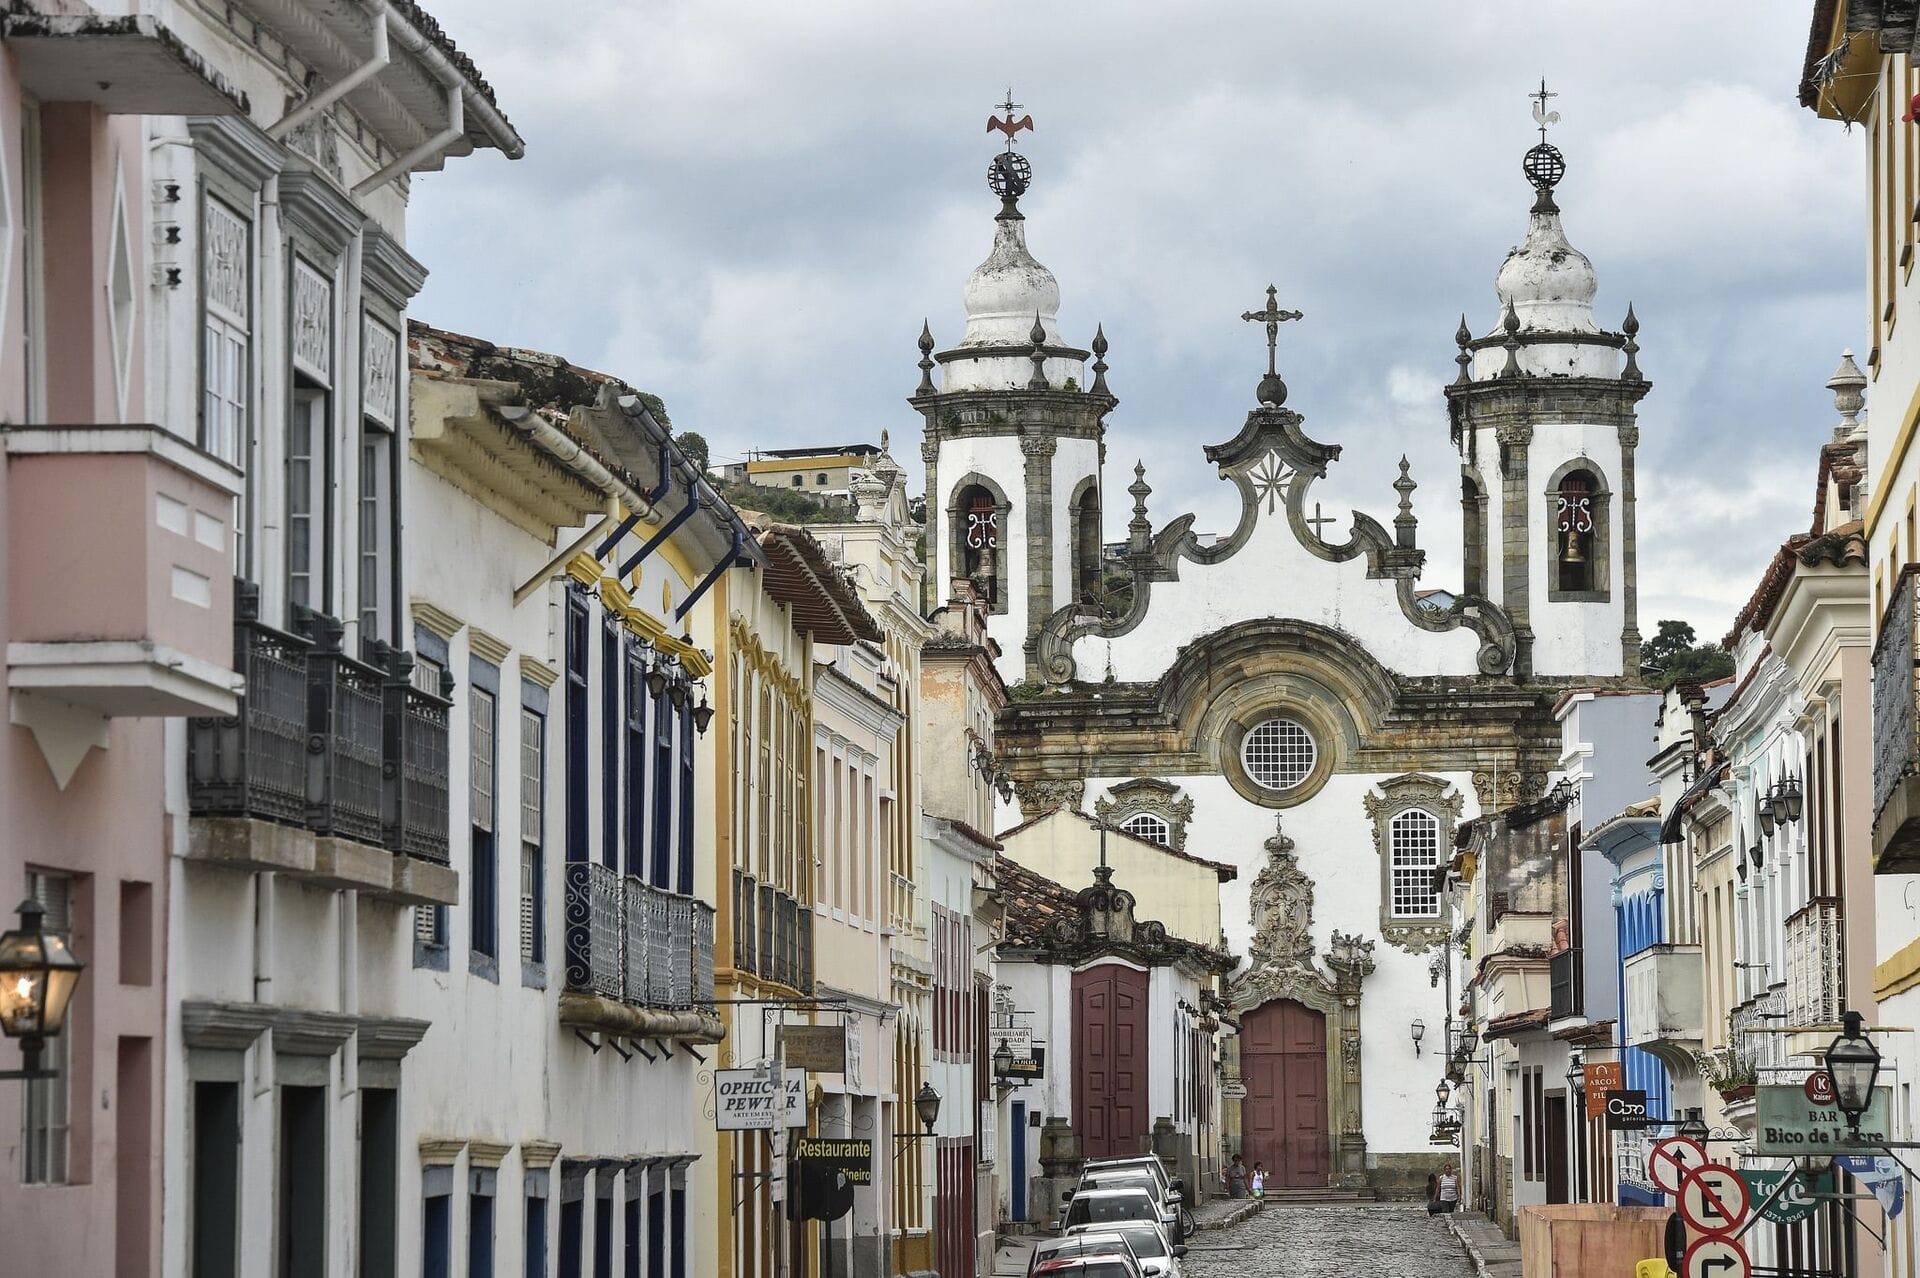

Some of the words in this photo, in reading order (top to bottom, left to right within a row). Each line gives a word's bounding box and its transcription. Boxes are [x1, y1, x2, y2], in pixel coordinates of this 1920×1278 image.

[1590, 1078, 1617, 1086] ARCOS
[724, 1096, 797, 1111] PEWTR
[1813, 1093, 1832, 1101] Kaiser
[1808, 1111, 1838, 1122] BAR
[1765, 1127, 1804, 1144] Bico
[1808, 1127, 1829, 1144] de
[1833, 1128, 1884, 1143] Lcre
[799, 1139, 870, 1158] Restaurante
[1702, 1181, 1723, 1218] E
